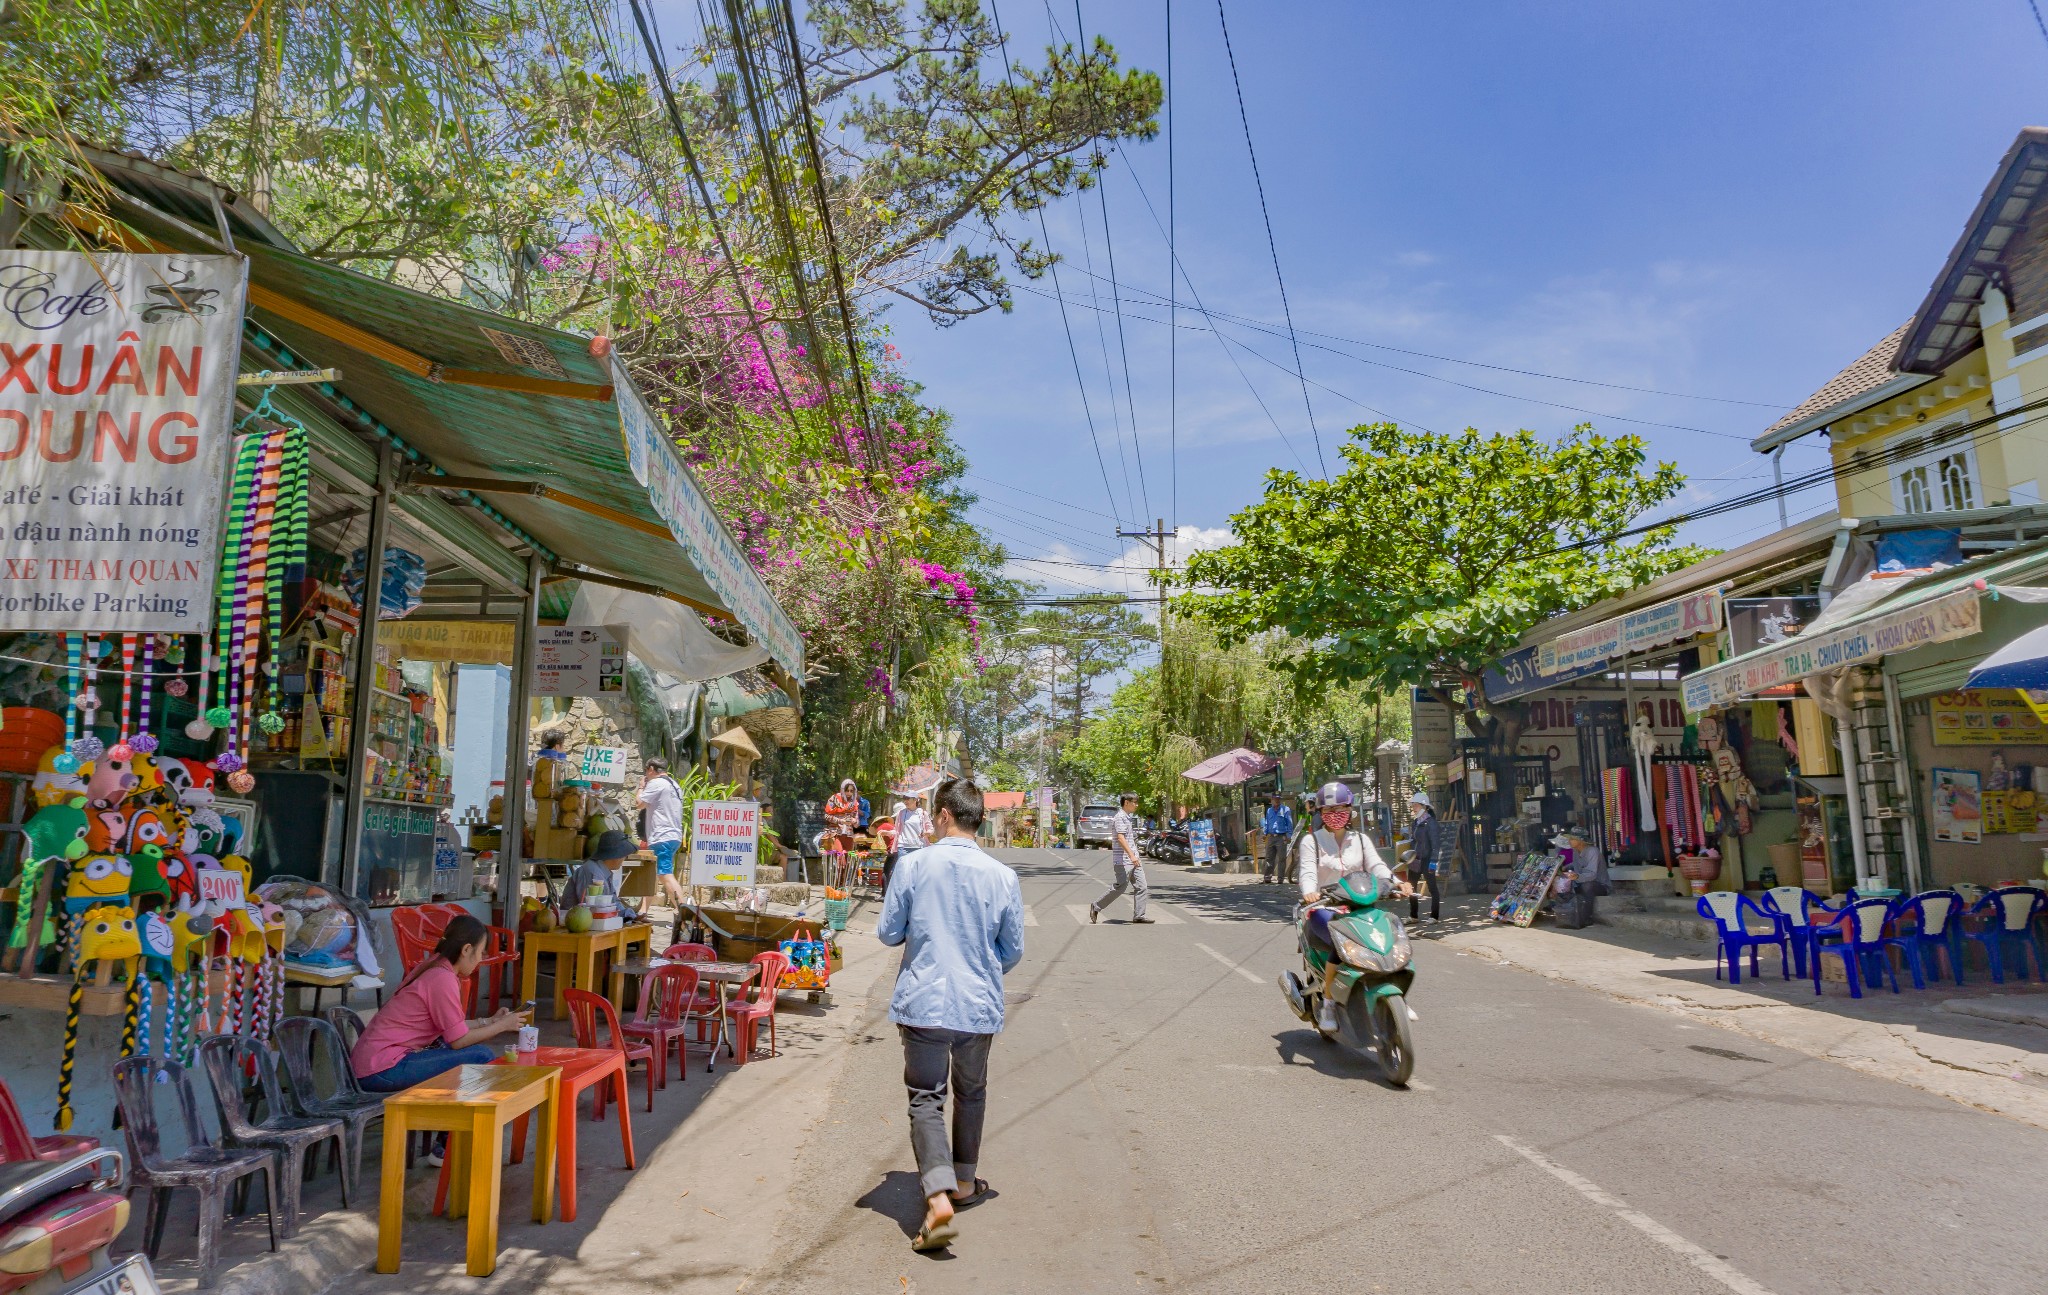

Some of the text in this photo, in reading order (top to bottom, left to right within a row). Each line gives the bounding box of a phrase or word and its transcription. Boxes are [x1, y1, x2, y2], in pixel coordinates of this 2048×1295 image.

[0, 331, 203, 397] XUÂN
[0, 410, 199, 464] DUNG
[0, 484, 41, 505] afé
[68, 485, 121, 506] Giải
[128, 486, 185, 506] khát
[14, 521, 200, 547] đậu nành nóng
[3, 559, 201, 585] XE THAM QUAN
[93, 593, 189, 617] Parking
[1576, 647, 1597, 662] MADE
[1599, 640, 1617, 655] SHOP
[1505, 658, 1524, 685] CÔ
[698, 803, 722, 820] ĐIỂM
[742, 811, 755, 821] XE
[699, 824, 752, 837] THAM QUAN
[696, 841, 753, 852] MOTORBIKE PARKING
[705, 855, 742, 865] CRAZY HOUSE
